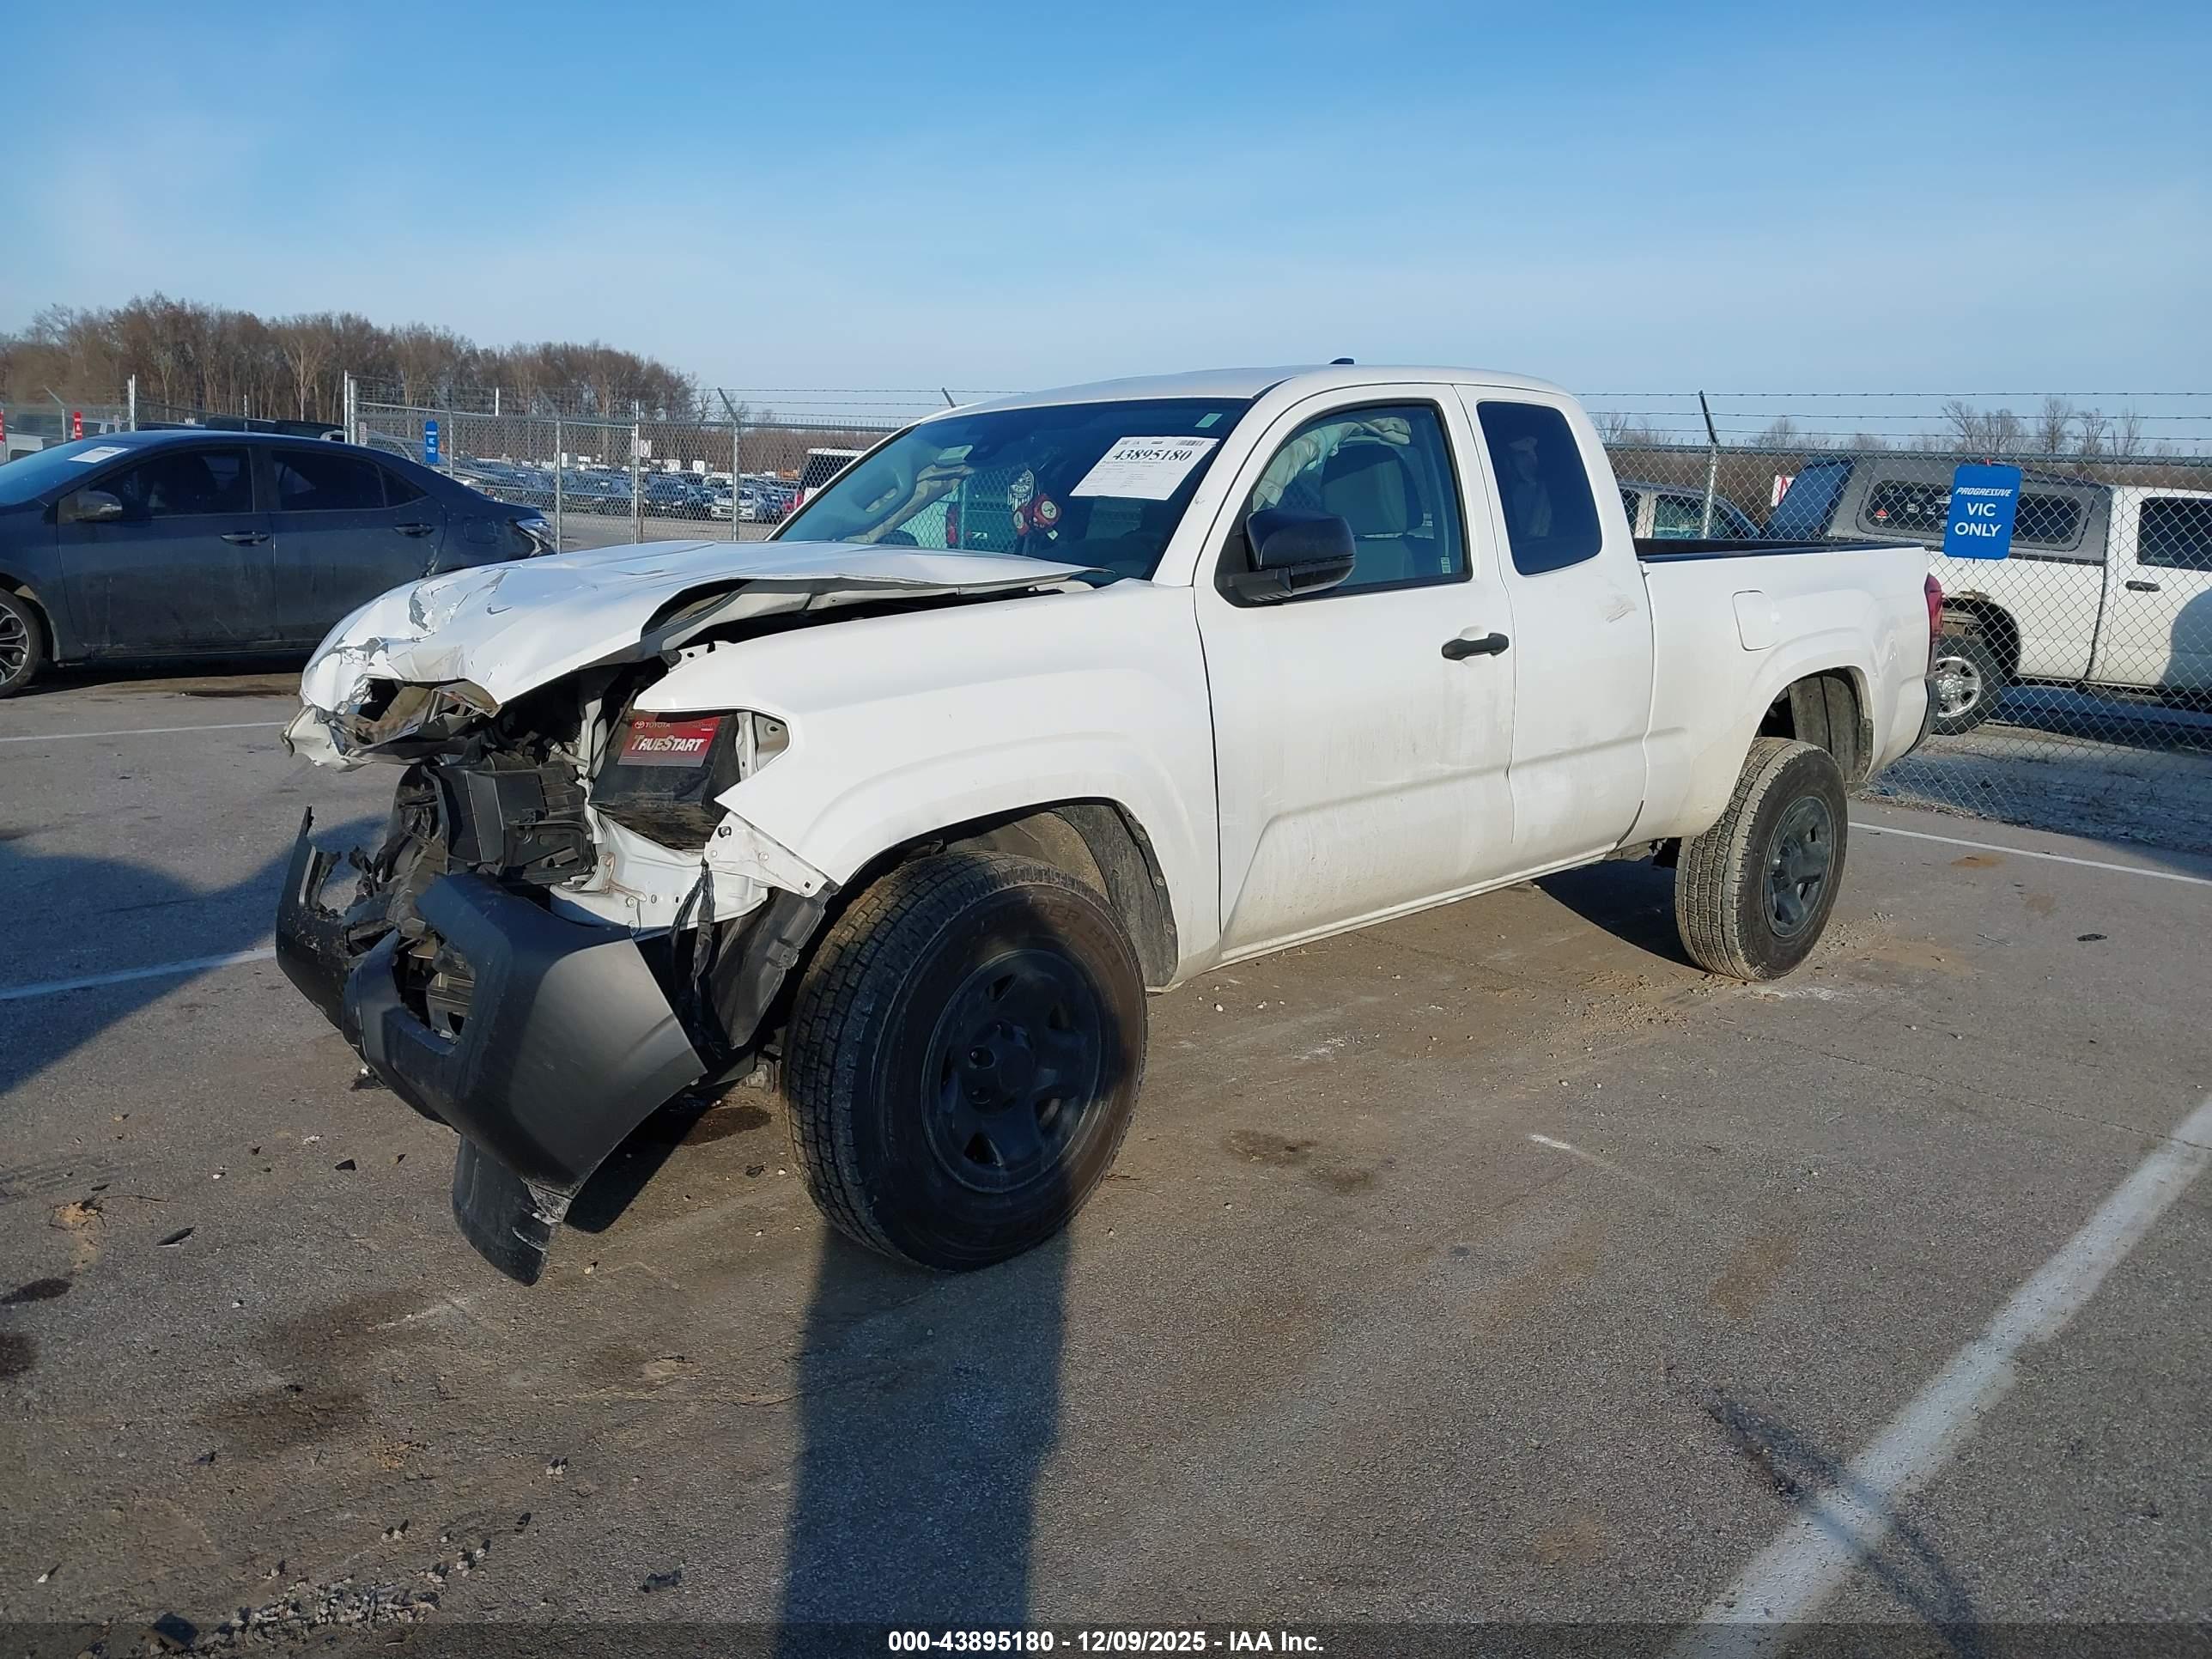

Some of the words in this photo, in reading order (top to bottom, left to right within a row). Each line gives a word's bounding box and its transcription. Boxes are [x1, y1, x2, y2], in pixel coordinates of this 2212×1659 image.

[1113, 449, 1193, 462] 43895180
[1955, 487, 2014, 497] PROGRESSIVE
[1966, 501, 1996, 517] VIC
[1954, 521, 2002, 538] ONLY
